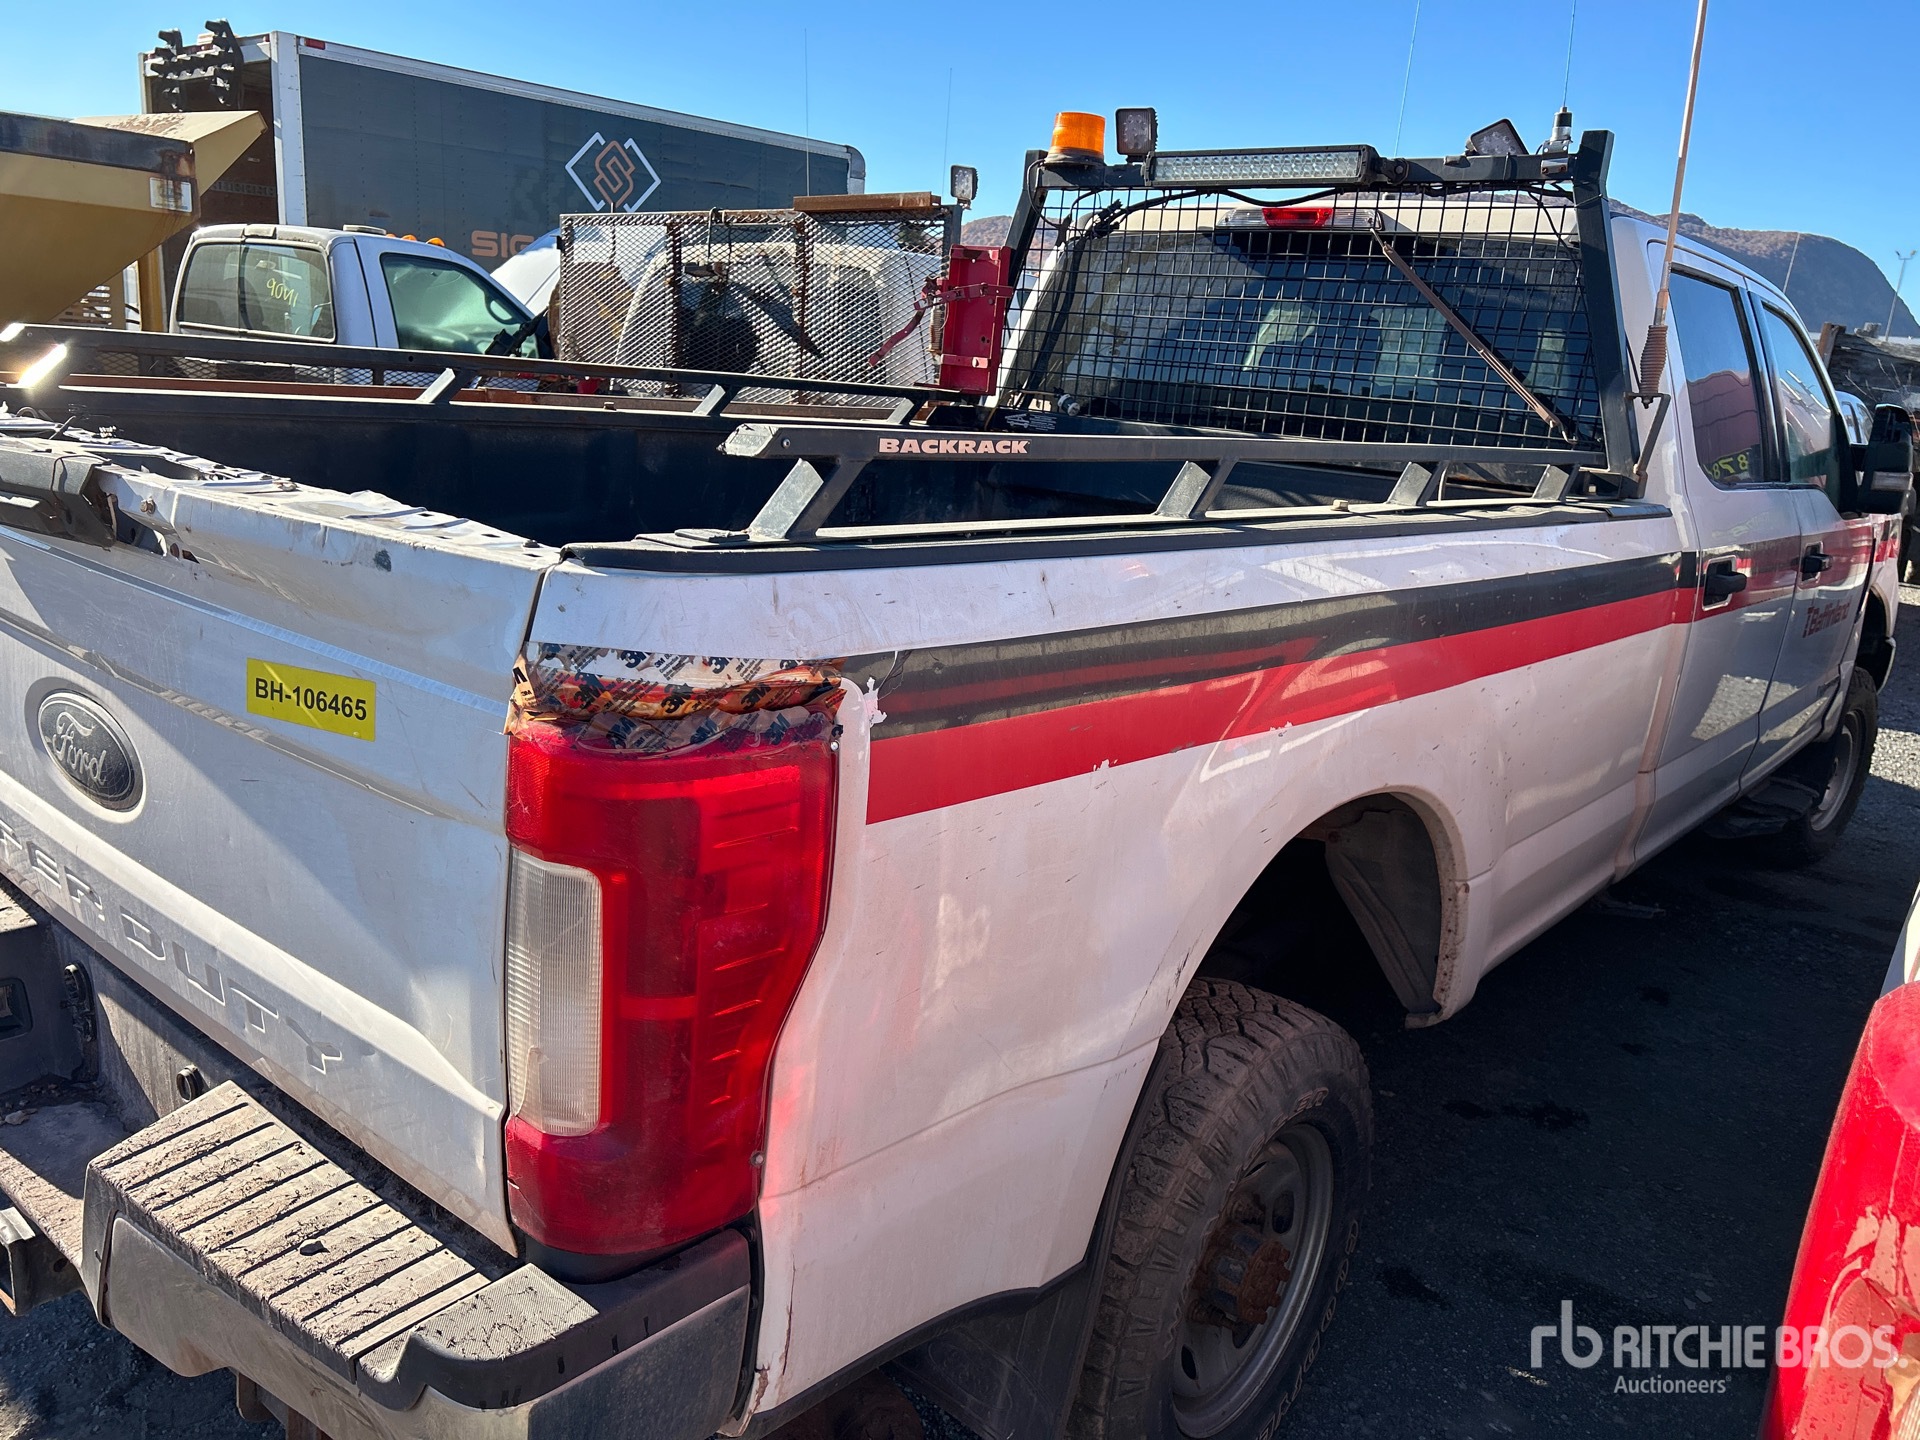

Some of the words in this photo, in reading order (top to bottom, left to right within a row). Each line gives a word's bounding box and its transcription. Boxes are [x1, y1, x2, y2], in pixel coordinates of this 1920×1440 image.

[878, 437, 1031, 455] BACKRACK
[255, 677, 368, 721] BH-106465
[51, 710, 107, 786] Ford
[119, 904, 343, 1075] DUTY
